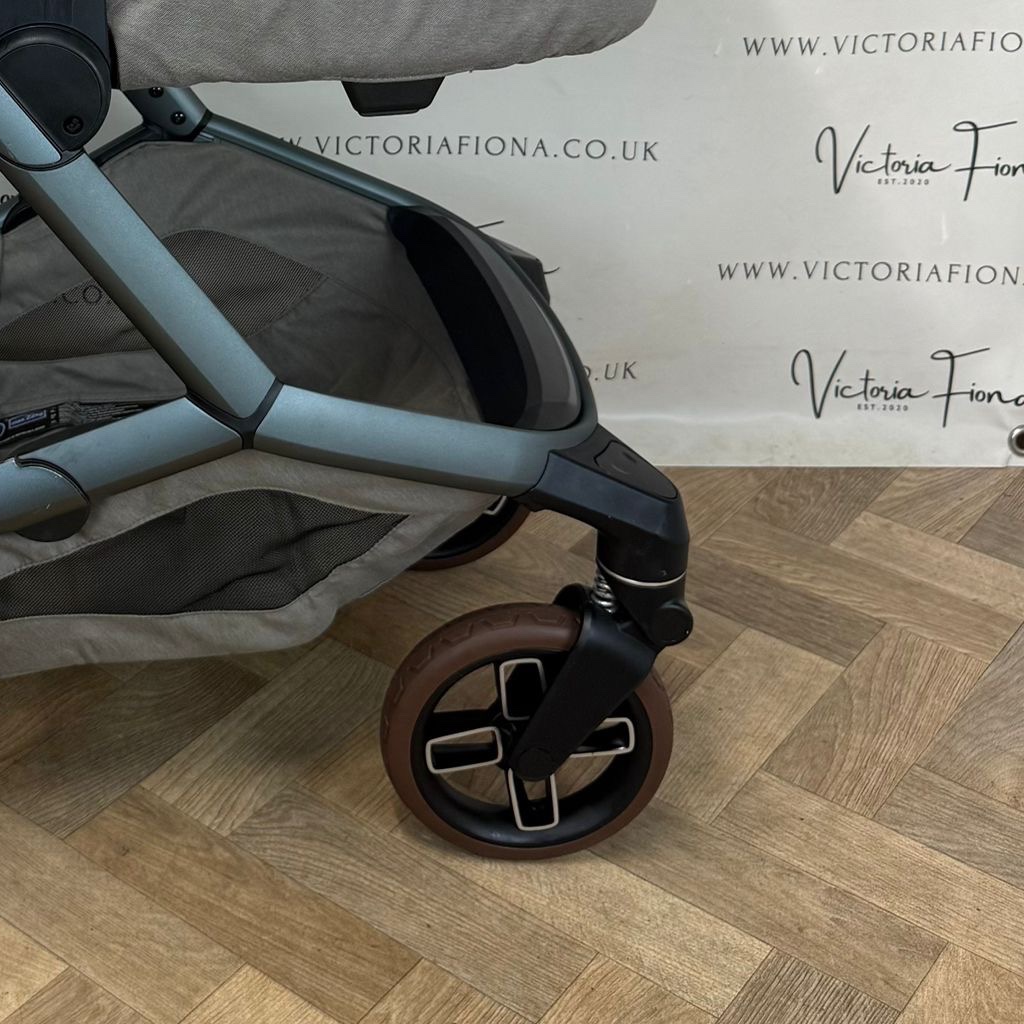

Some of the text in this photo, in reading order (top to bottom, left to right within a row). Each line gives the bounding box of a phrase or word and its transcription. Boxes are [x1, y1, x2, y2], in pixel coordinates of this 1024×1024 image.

[815, 124, 952, 195] Victoria
[877, 178, 930, 186] EST.2020
[791, 349, 930, 419] Victoria
[857, 403, 909, 412] EST.2020
